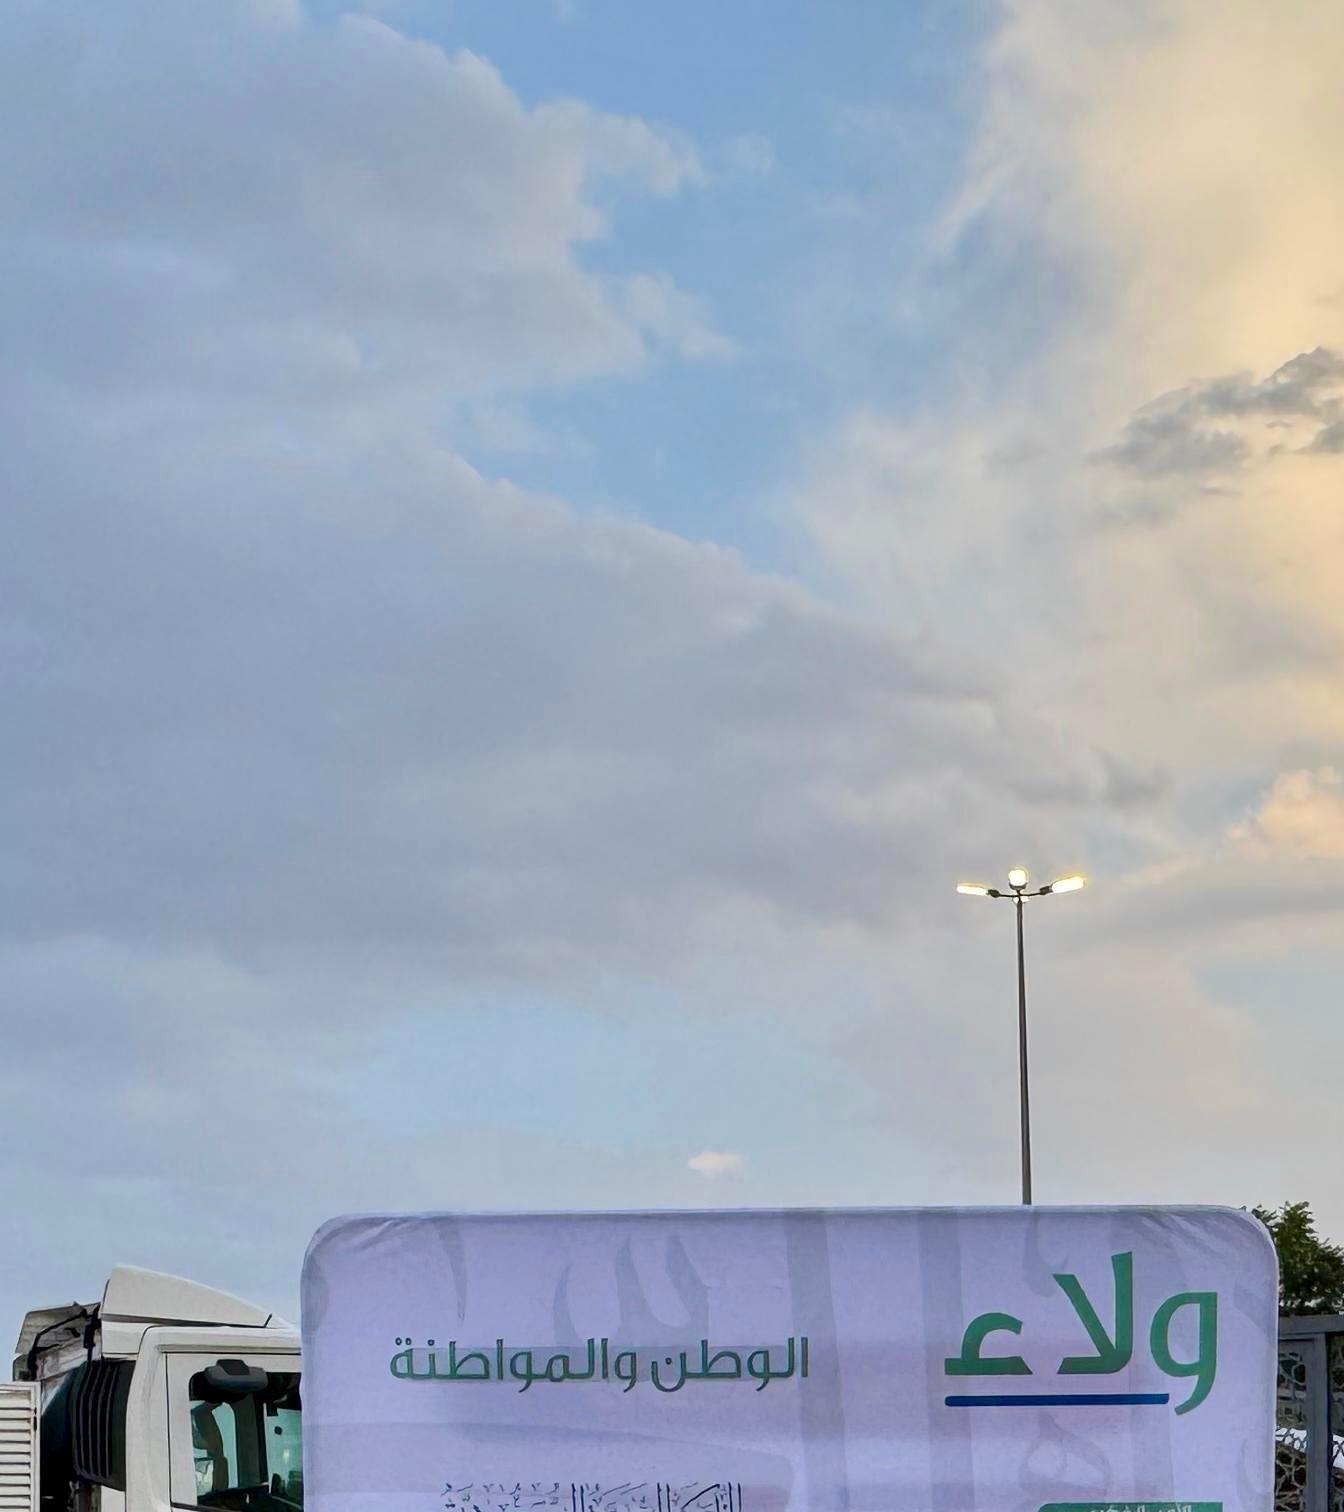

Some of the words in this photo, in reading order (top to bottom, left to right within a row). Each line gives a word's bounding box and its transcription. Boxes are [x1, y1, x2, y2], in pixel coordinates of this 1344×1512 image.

[944, 1251, 1218, 1415] ولاء
[389, 1336, 639, 1393] والمواطنة
[650, 1336, 810, 1393] الوطن
